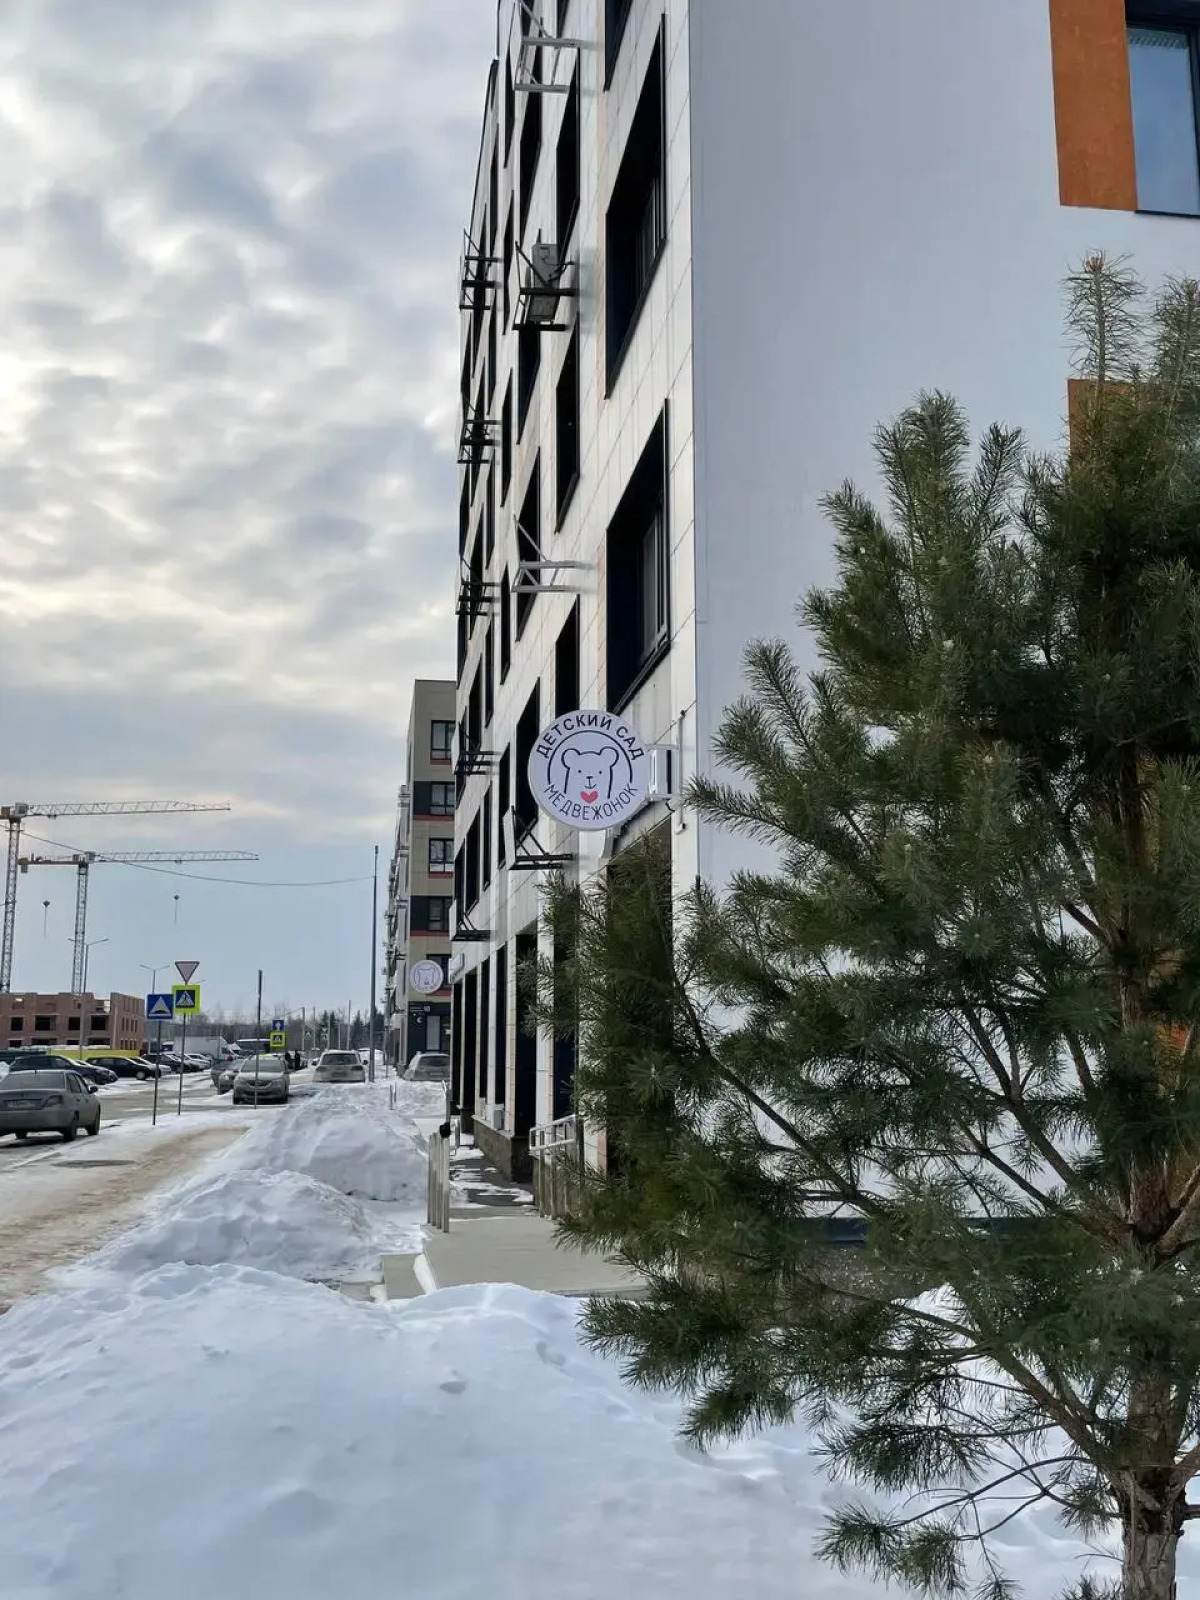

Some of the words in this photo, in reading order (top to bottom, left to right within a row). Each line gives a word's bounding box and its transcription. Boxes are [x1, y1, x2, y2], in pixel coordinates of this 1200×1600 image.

[536, 714, 612, 759] ДЕТСКИЙ
[616, 726, 645, 760] САД
[544, 783, 638, 820] МЕДВЕЖОНОК
